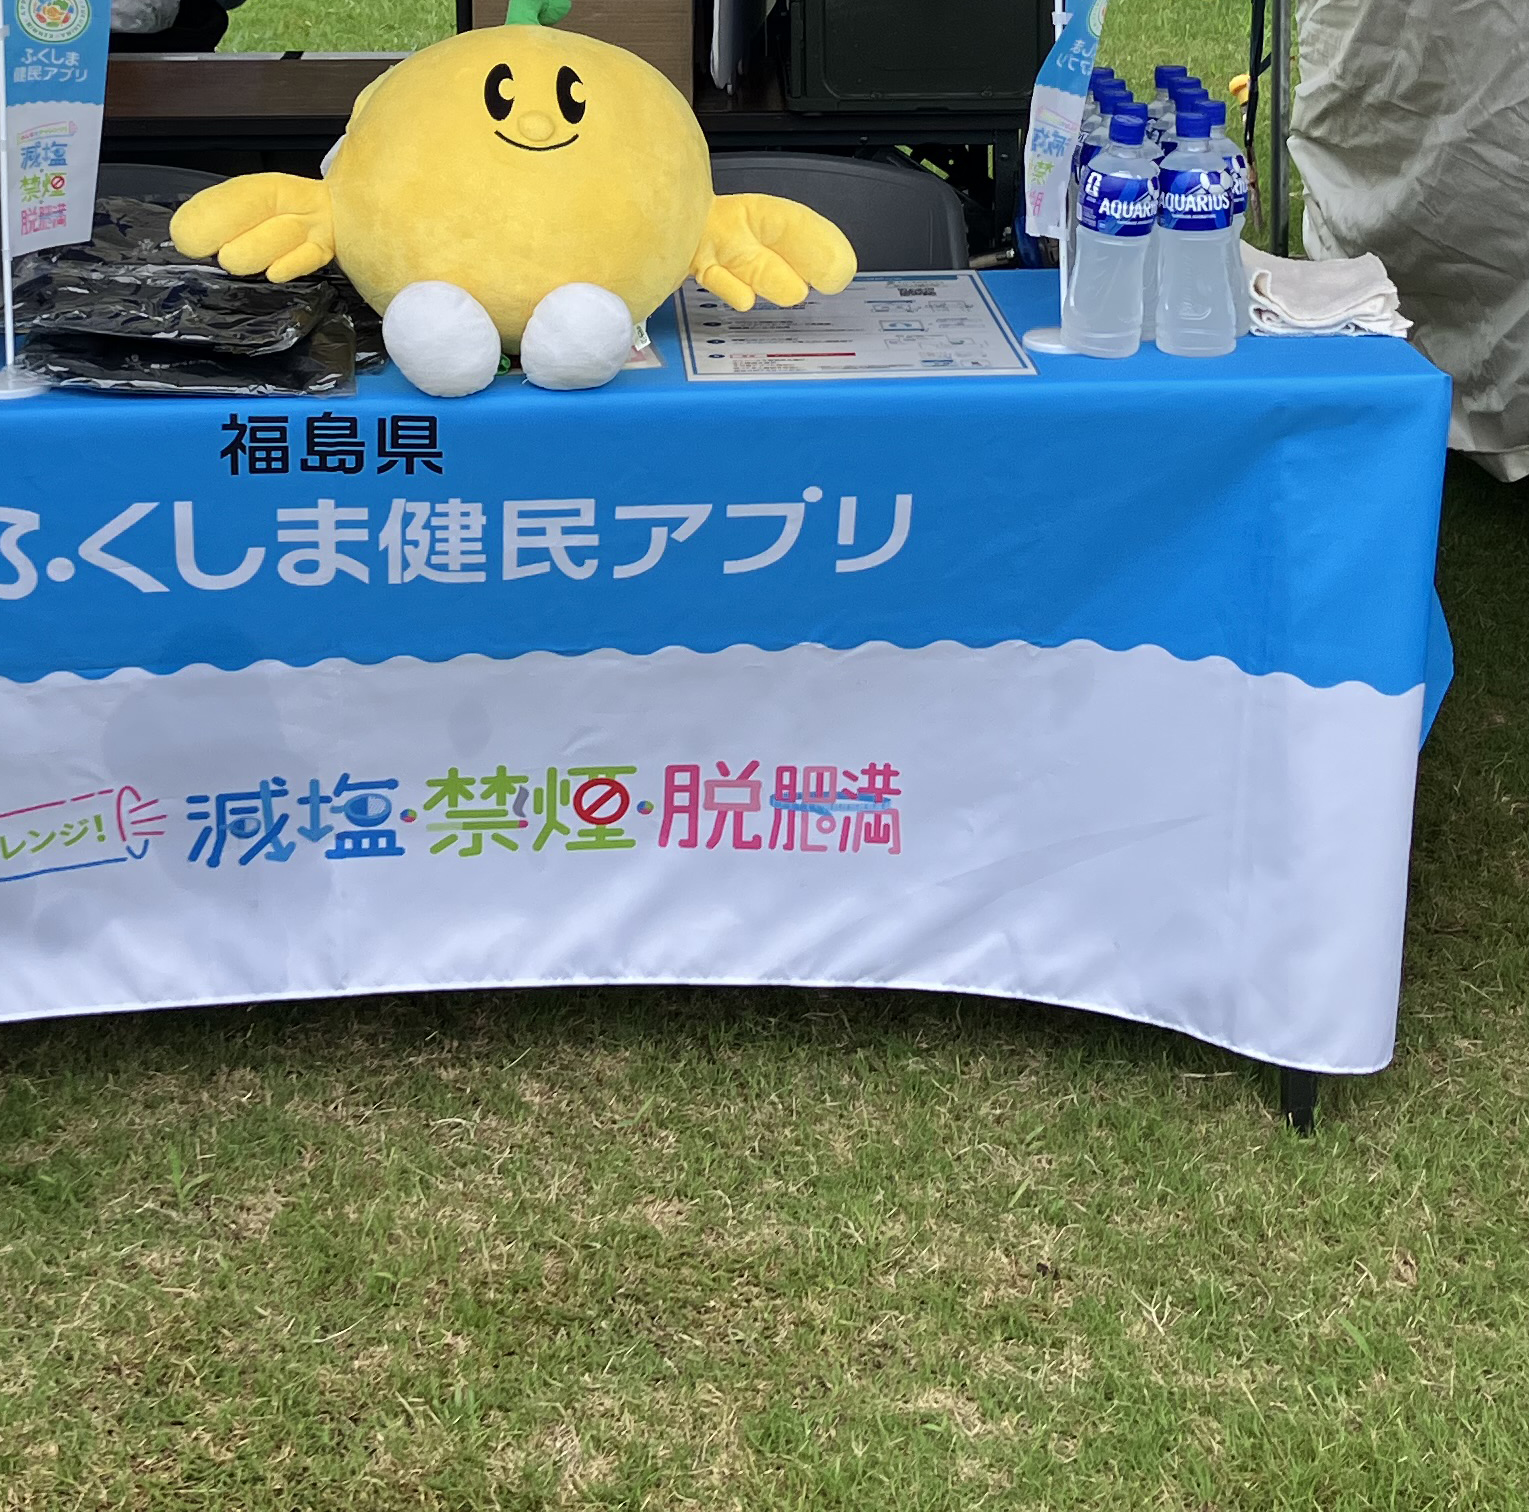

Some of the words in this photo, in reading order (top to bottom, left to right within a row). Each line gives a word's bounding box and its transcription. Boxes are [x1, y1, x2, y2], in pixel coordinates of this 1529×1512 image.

[21, 48, 80, 66] ふくしま
[220, 411, 444, 476] 福島県
